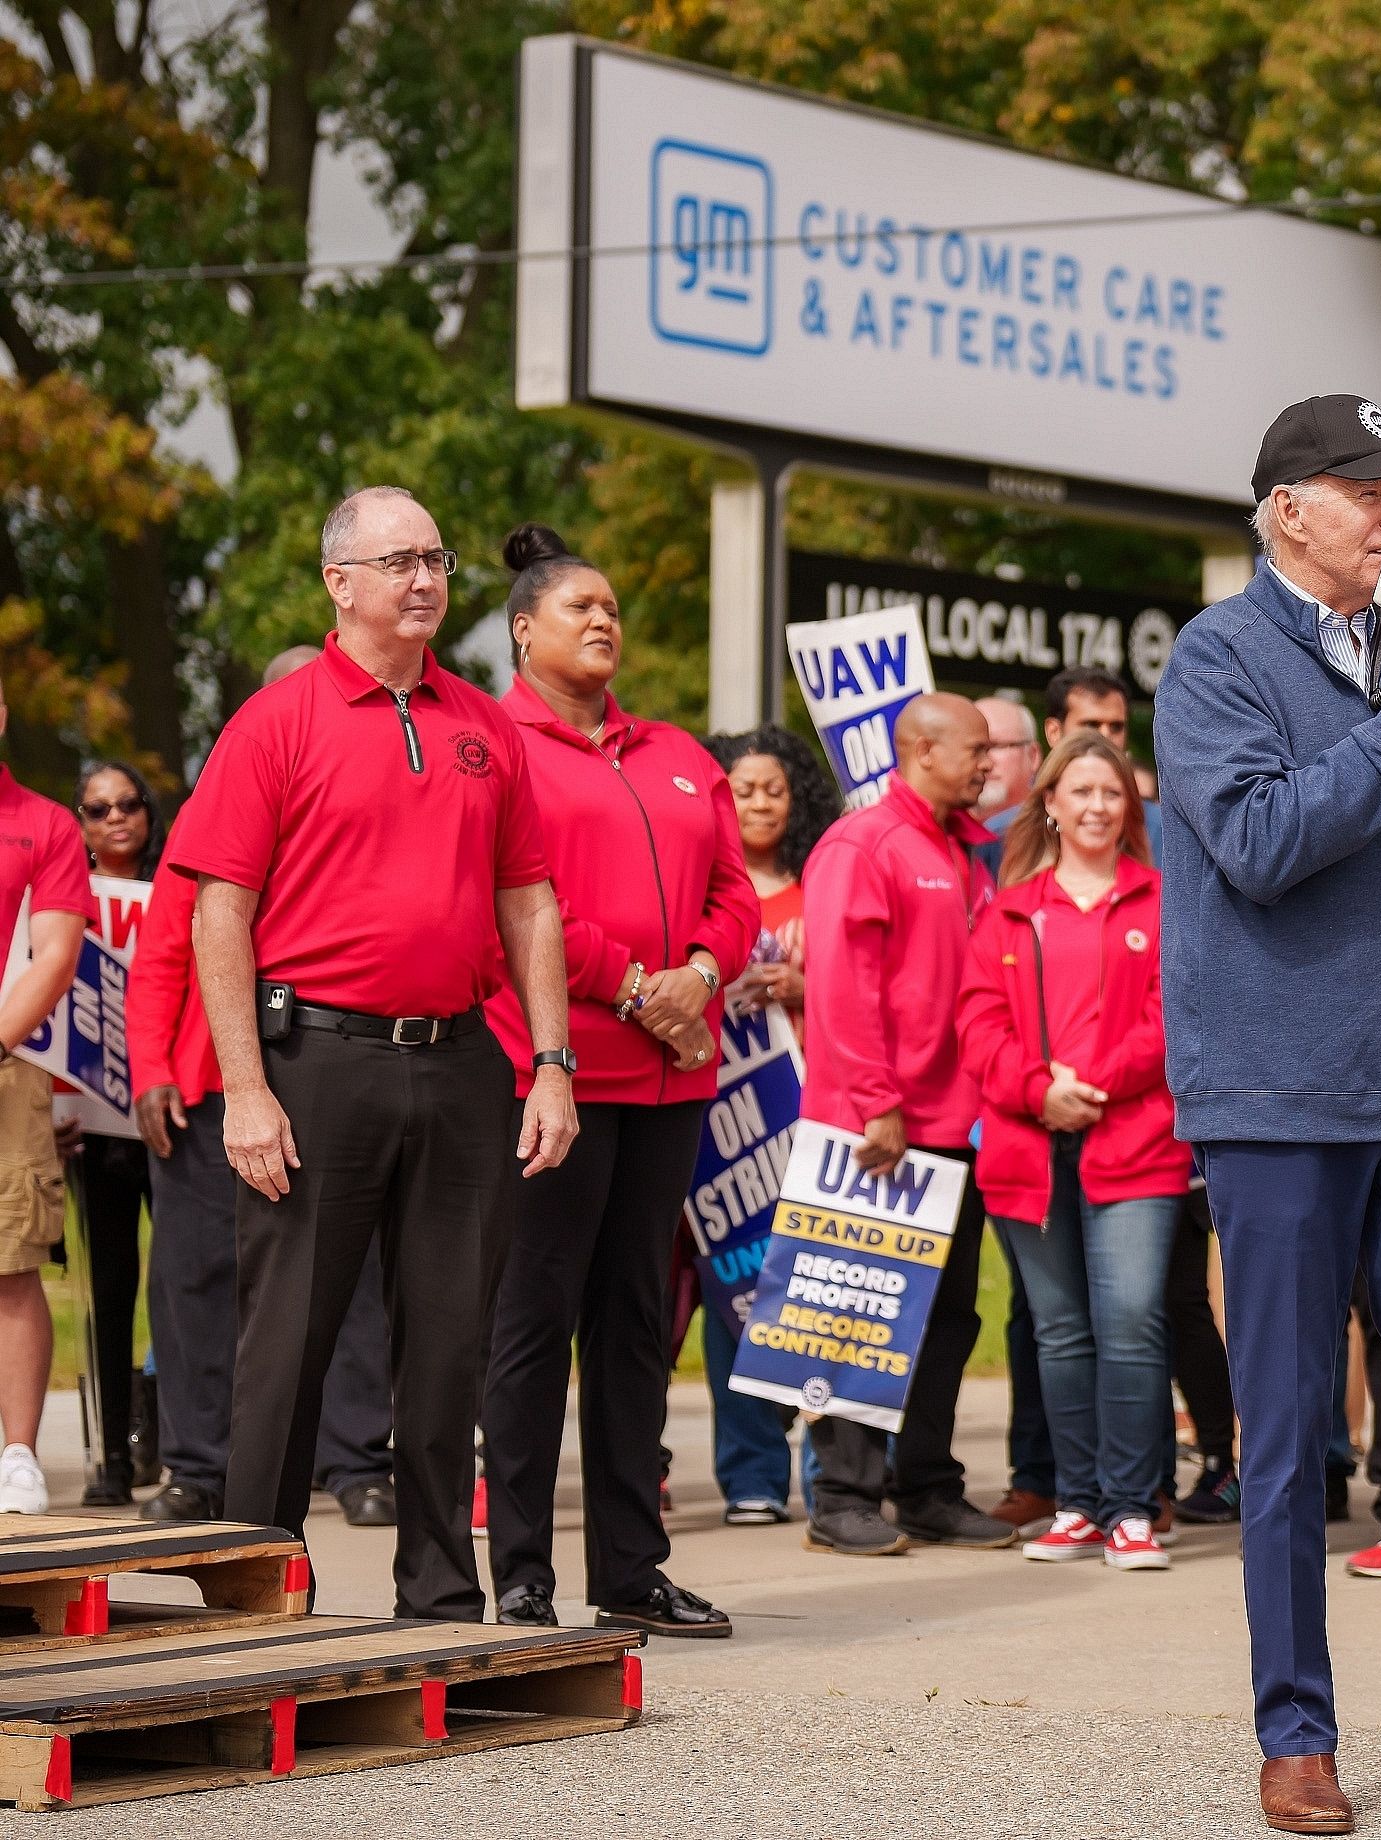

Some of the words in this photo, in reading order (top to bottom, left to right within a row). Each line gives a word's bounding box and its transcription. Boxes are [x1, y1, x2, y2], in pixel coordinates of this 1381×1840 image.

[674, 194, 751, 294] gm
[800, 202, 1081, 311] CUSTOMER
[1104, 264, 1226, 342] CARE
[800, 275, 829, 339] &
[850, 288, 1178, 400] AFTERSALES
[799, 633, 907, 701] UAW
[926, 593, 1058, 669] LOCAL
[1060, 610, 1123, 673] 174
[841, 713, 894, 783] ON
[73, 978, 101, 1045] ON
[100, 953, 129, 1107] STRIKE
[709, 1082, 767, 1160] ON
[817, 1139, 936, 1216] UAW
[785, 1212, 884, 1247] STAND
[898, 1234, 936, 1257] UP
[787, 1276, 901, 1320] PROFITS
[793, 1252, 907, 1294] RECORD
[748, 1323, 911, 1378] CONTRACTS
[778, 1304, 892, 1347] RECORD
